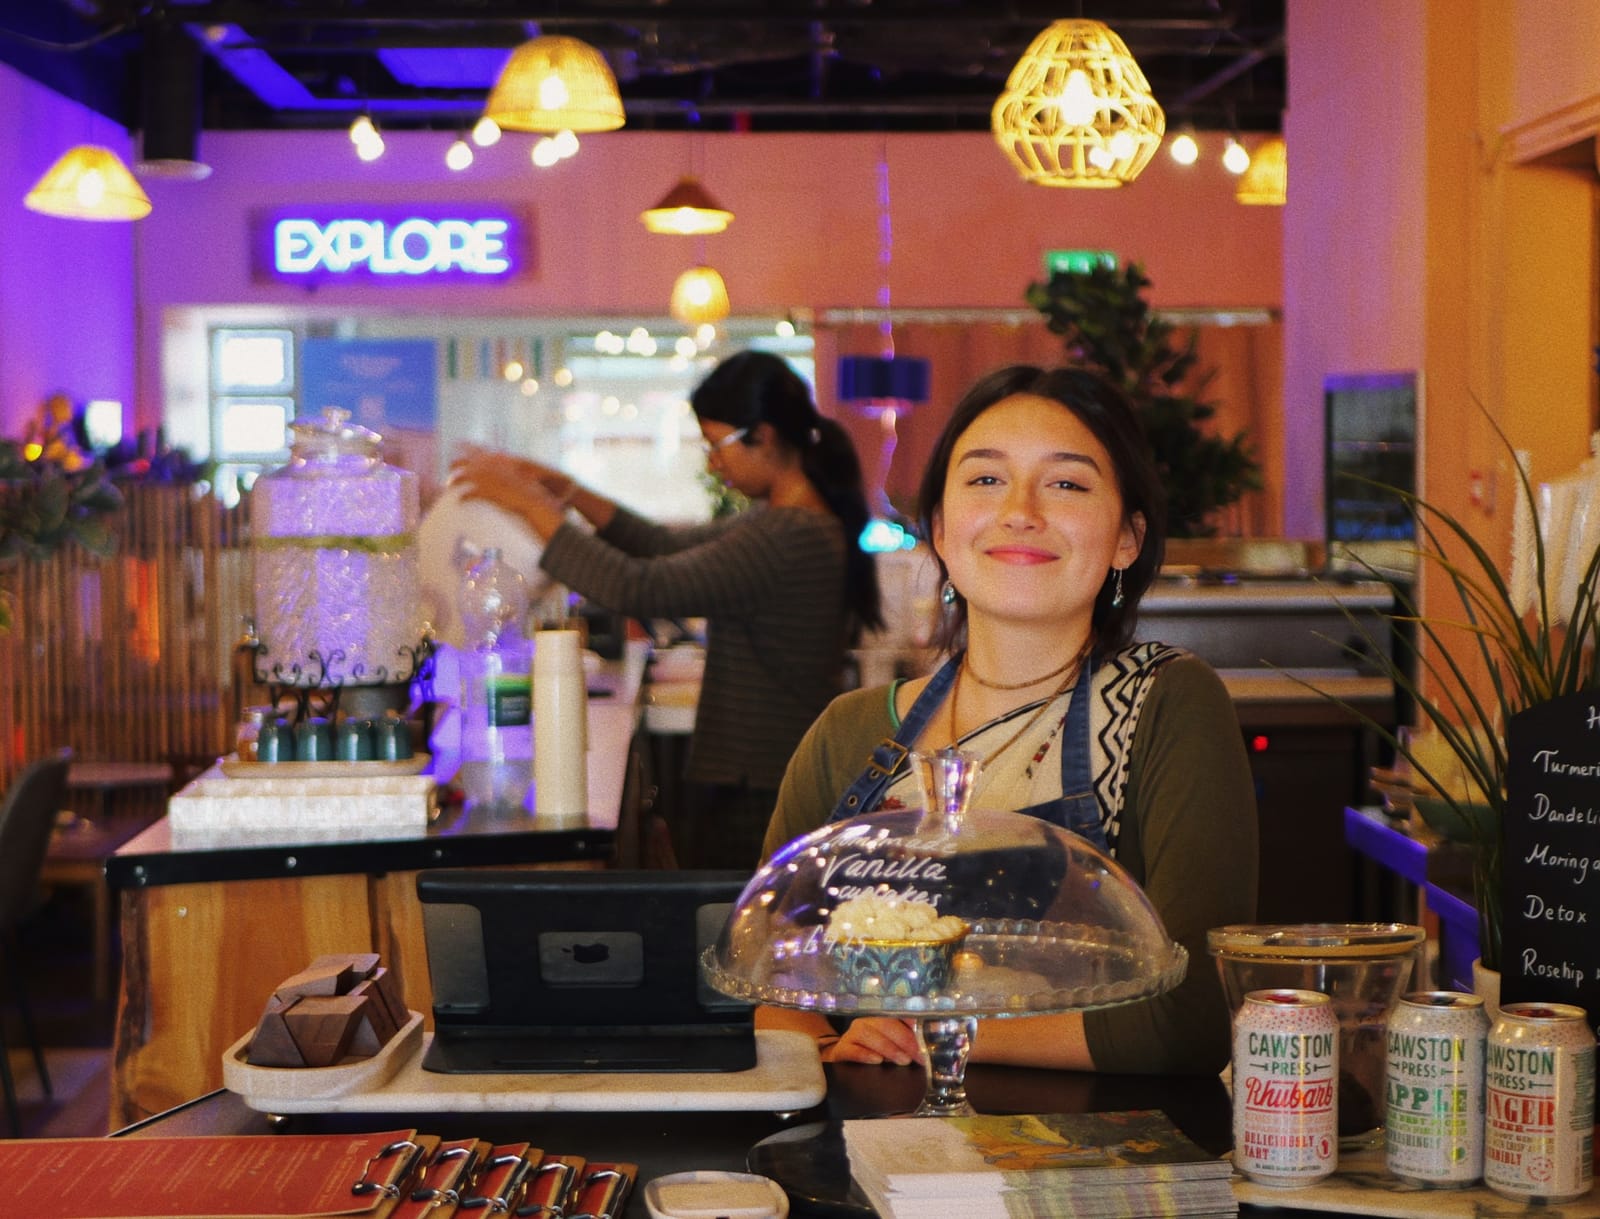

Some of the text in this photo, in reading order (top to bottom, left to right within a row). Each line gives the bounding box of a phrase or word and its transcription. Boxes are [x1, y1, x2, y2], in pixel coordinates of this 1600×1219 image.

[275, 217, 510, 275] EXPLORE
[1528, 793, 1600, 824] Dandeli
[821, 853, 948, 889] Vanilla
[1524, 843, 1600, 885] Moringa
[1523, 894, 1587, 924] Detox
[1522, 948, 1585, 988] Rosehip
[1249, 1032, 1333, 1059] CAWSTON
[1271, 1061, 1311, 1076] PRESS
[1401, 1061, 1438, 1079] PRESS
[1494, 1072, 1526, 1091] PRESS
[1245, 1076, 1334, 1109] Rhubarb
[1244, 1131, 1315, 1148] DELICIOUSLY
[1244, 1144, 1270, 1161] TART
